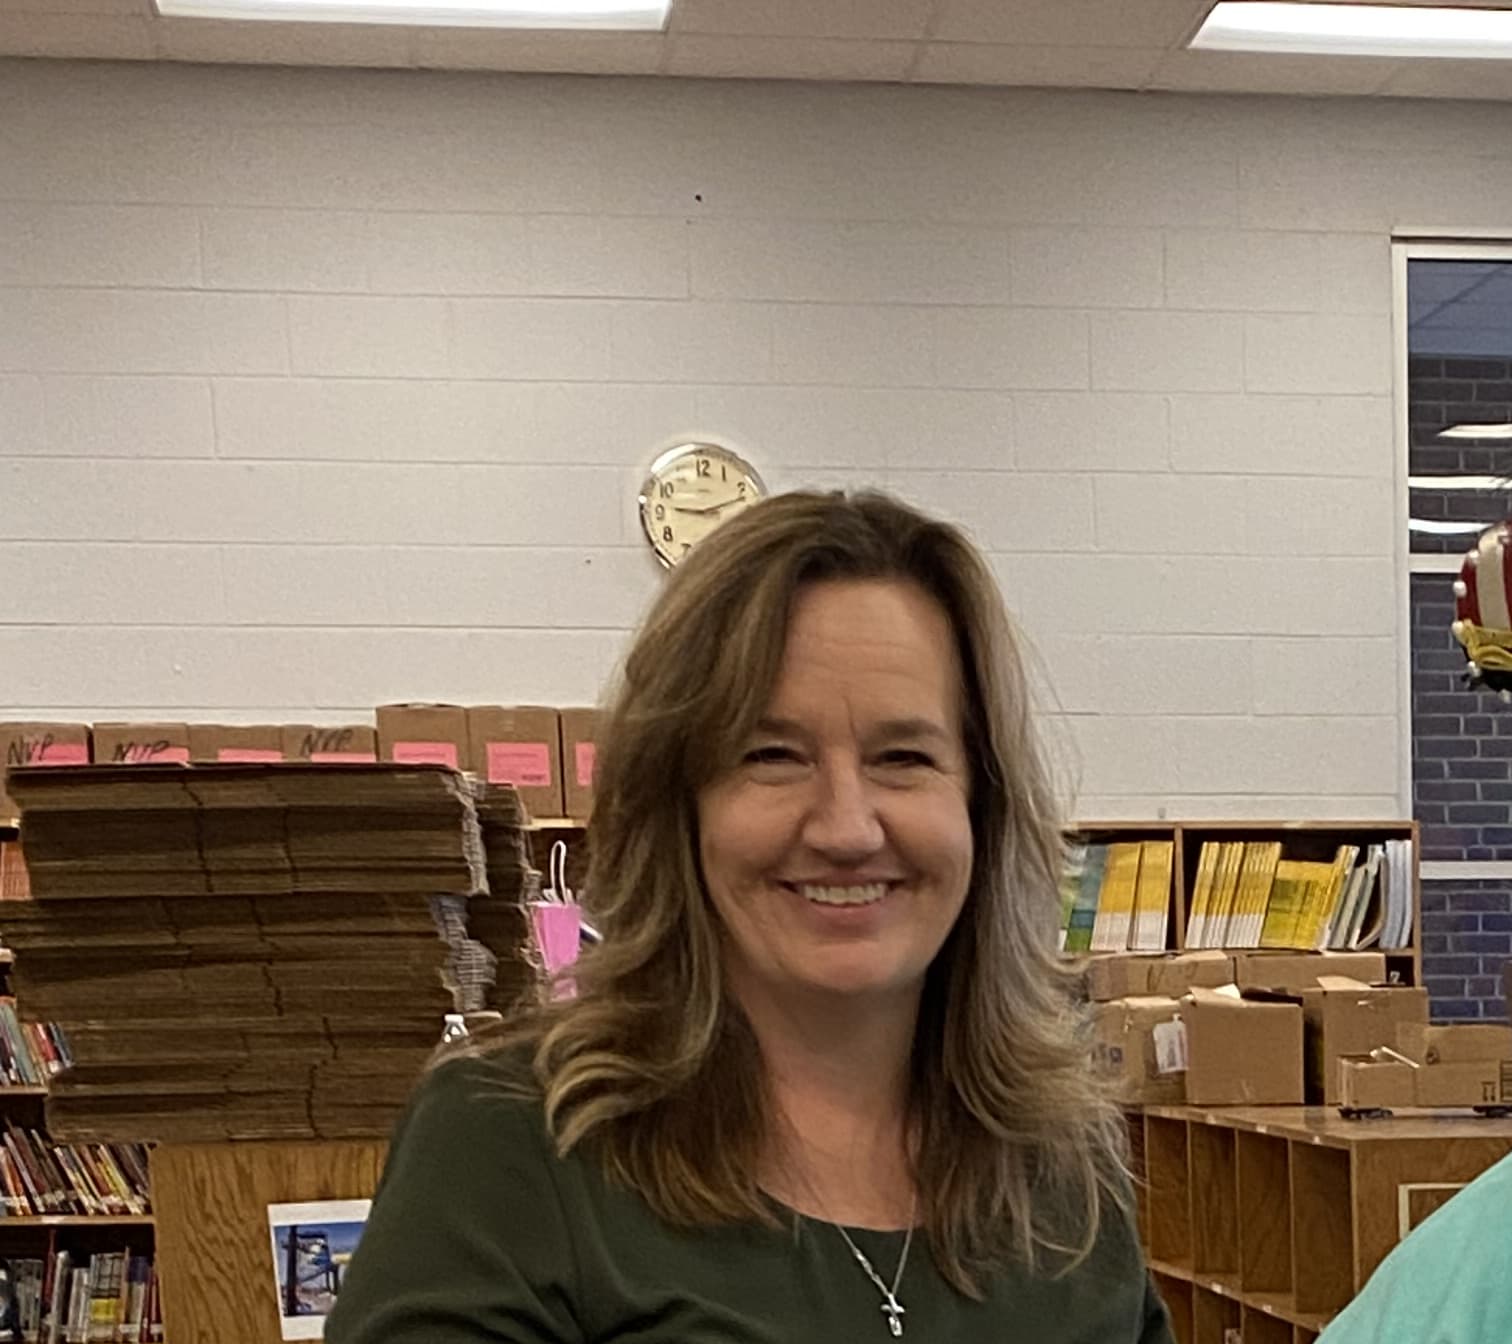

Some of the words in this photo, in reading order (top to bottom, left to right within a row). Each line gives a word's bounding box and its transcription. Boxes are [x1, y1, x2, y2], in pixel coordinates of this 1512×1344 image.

[696, 459, 711, 478] 12
[660, 481, 674, 499] 10
[655, 503, 665, 521] 9
[663, 525, 673, 542] 8
